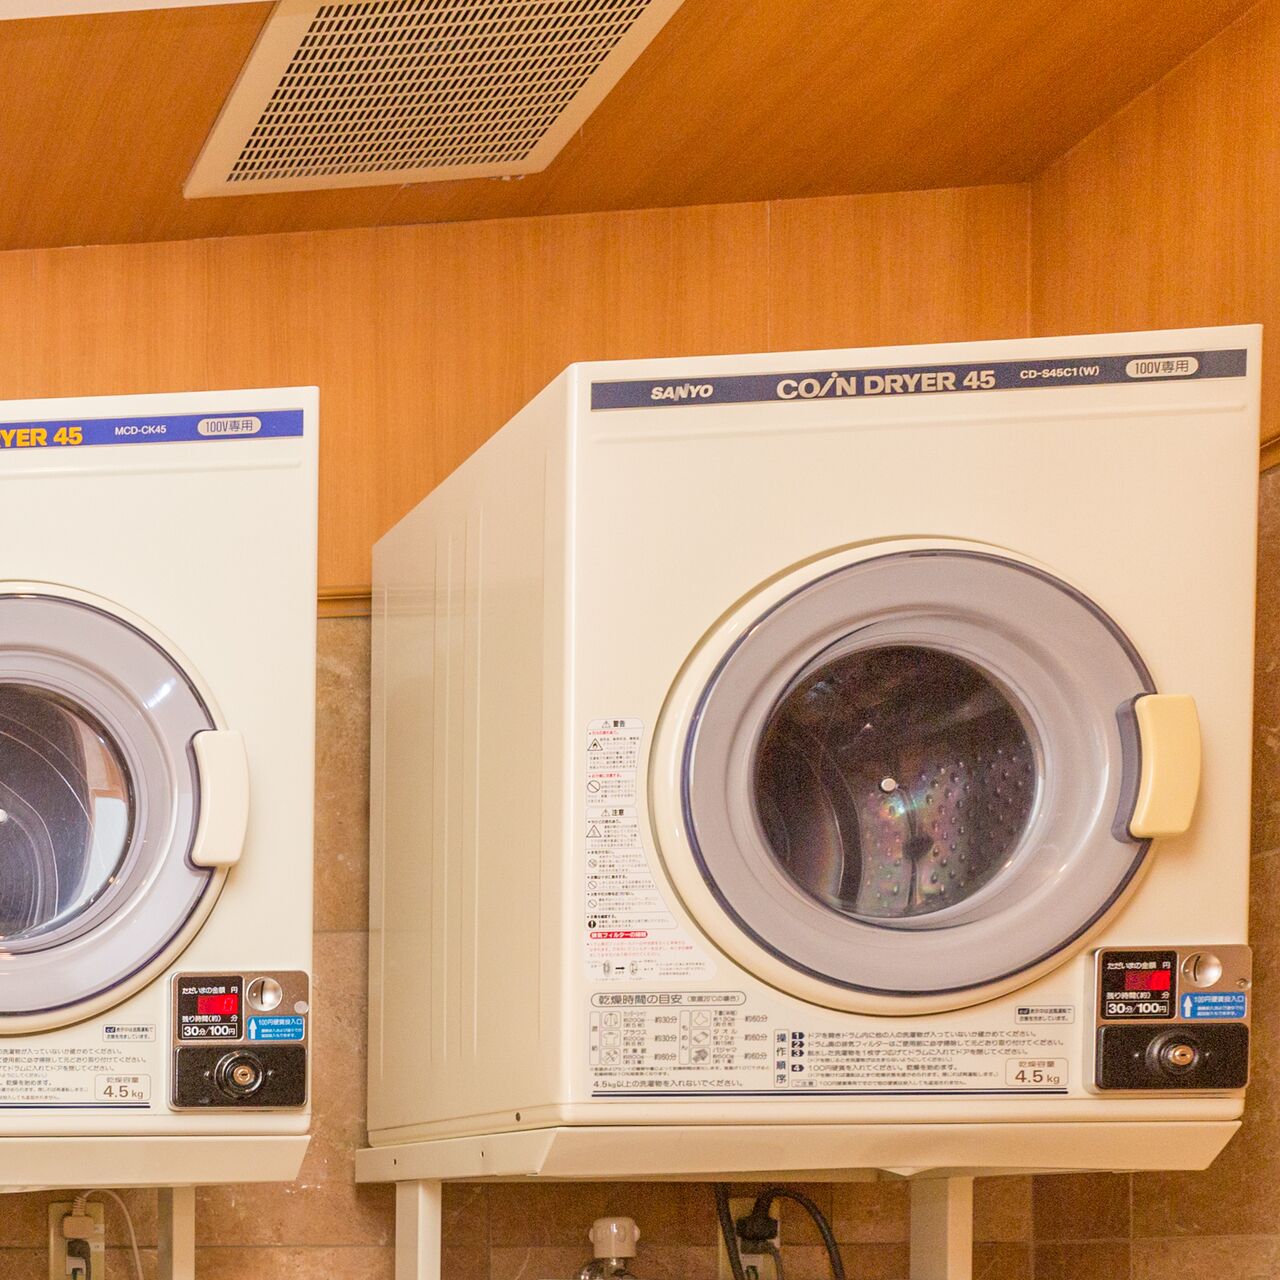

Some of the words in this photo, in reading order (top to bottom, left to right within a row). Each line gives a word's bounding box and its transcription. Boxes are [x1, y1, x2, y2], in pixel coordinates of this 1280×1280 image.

[1020, 365, 1100, 379] CD-S45C1(W)
[1135, 359, 1190, 375] 100V専用
[864, 371, 957, 395] DRYER
[962, 370, 996, 389] 45
[650, 383, 714, 401] SANYO
[114, 424, 167, 436] MCD-CK45
[205, 419, 254, 433] 100V専用
[53, 427, 83, 446] 45
[599, 994, 683, 1005] 乾燥時間の目安
[1108, 1003, 1167, 1013] 30分/100円
[184, 1026, 236, 1036] 30分/100円
[1015, 1070, 1044, 1083] 4.5
[1046, 1075, 1060, 1084] kg
[103, 1085, 128, 1097] 4.5
[131, 1090, 144, 1099] kg
